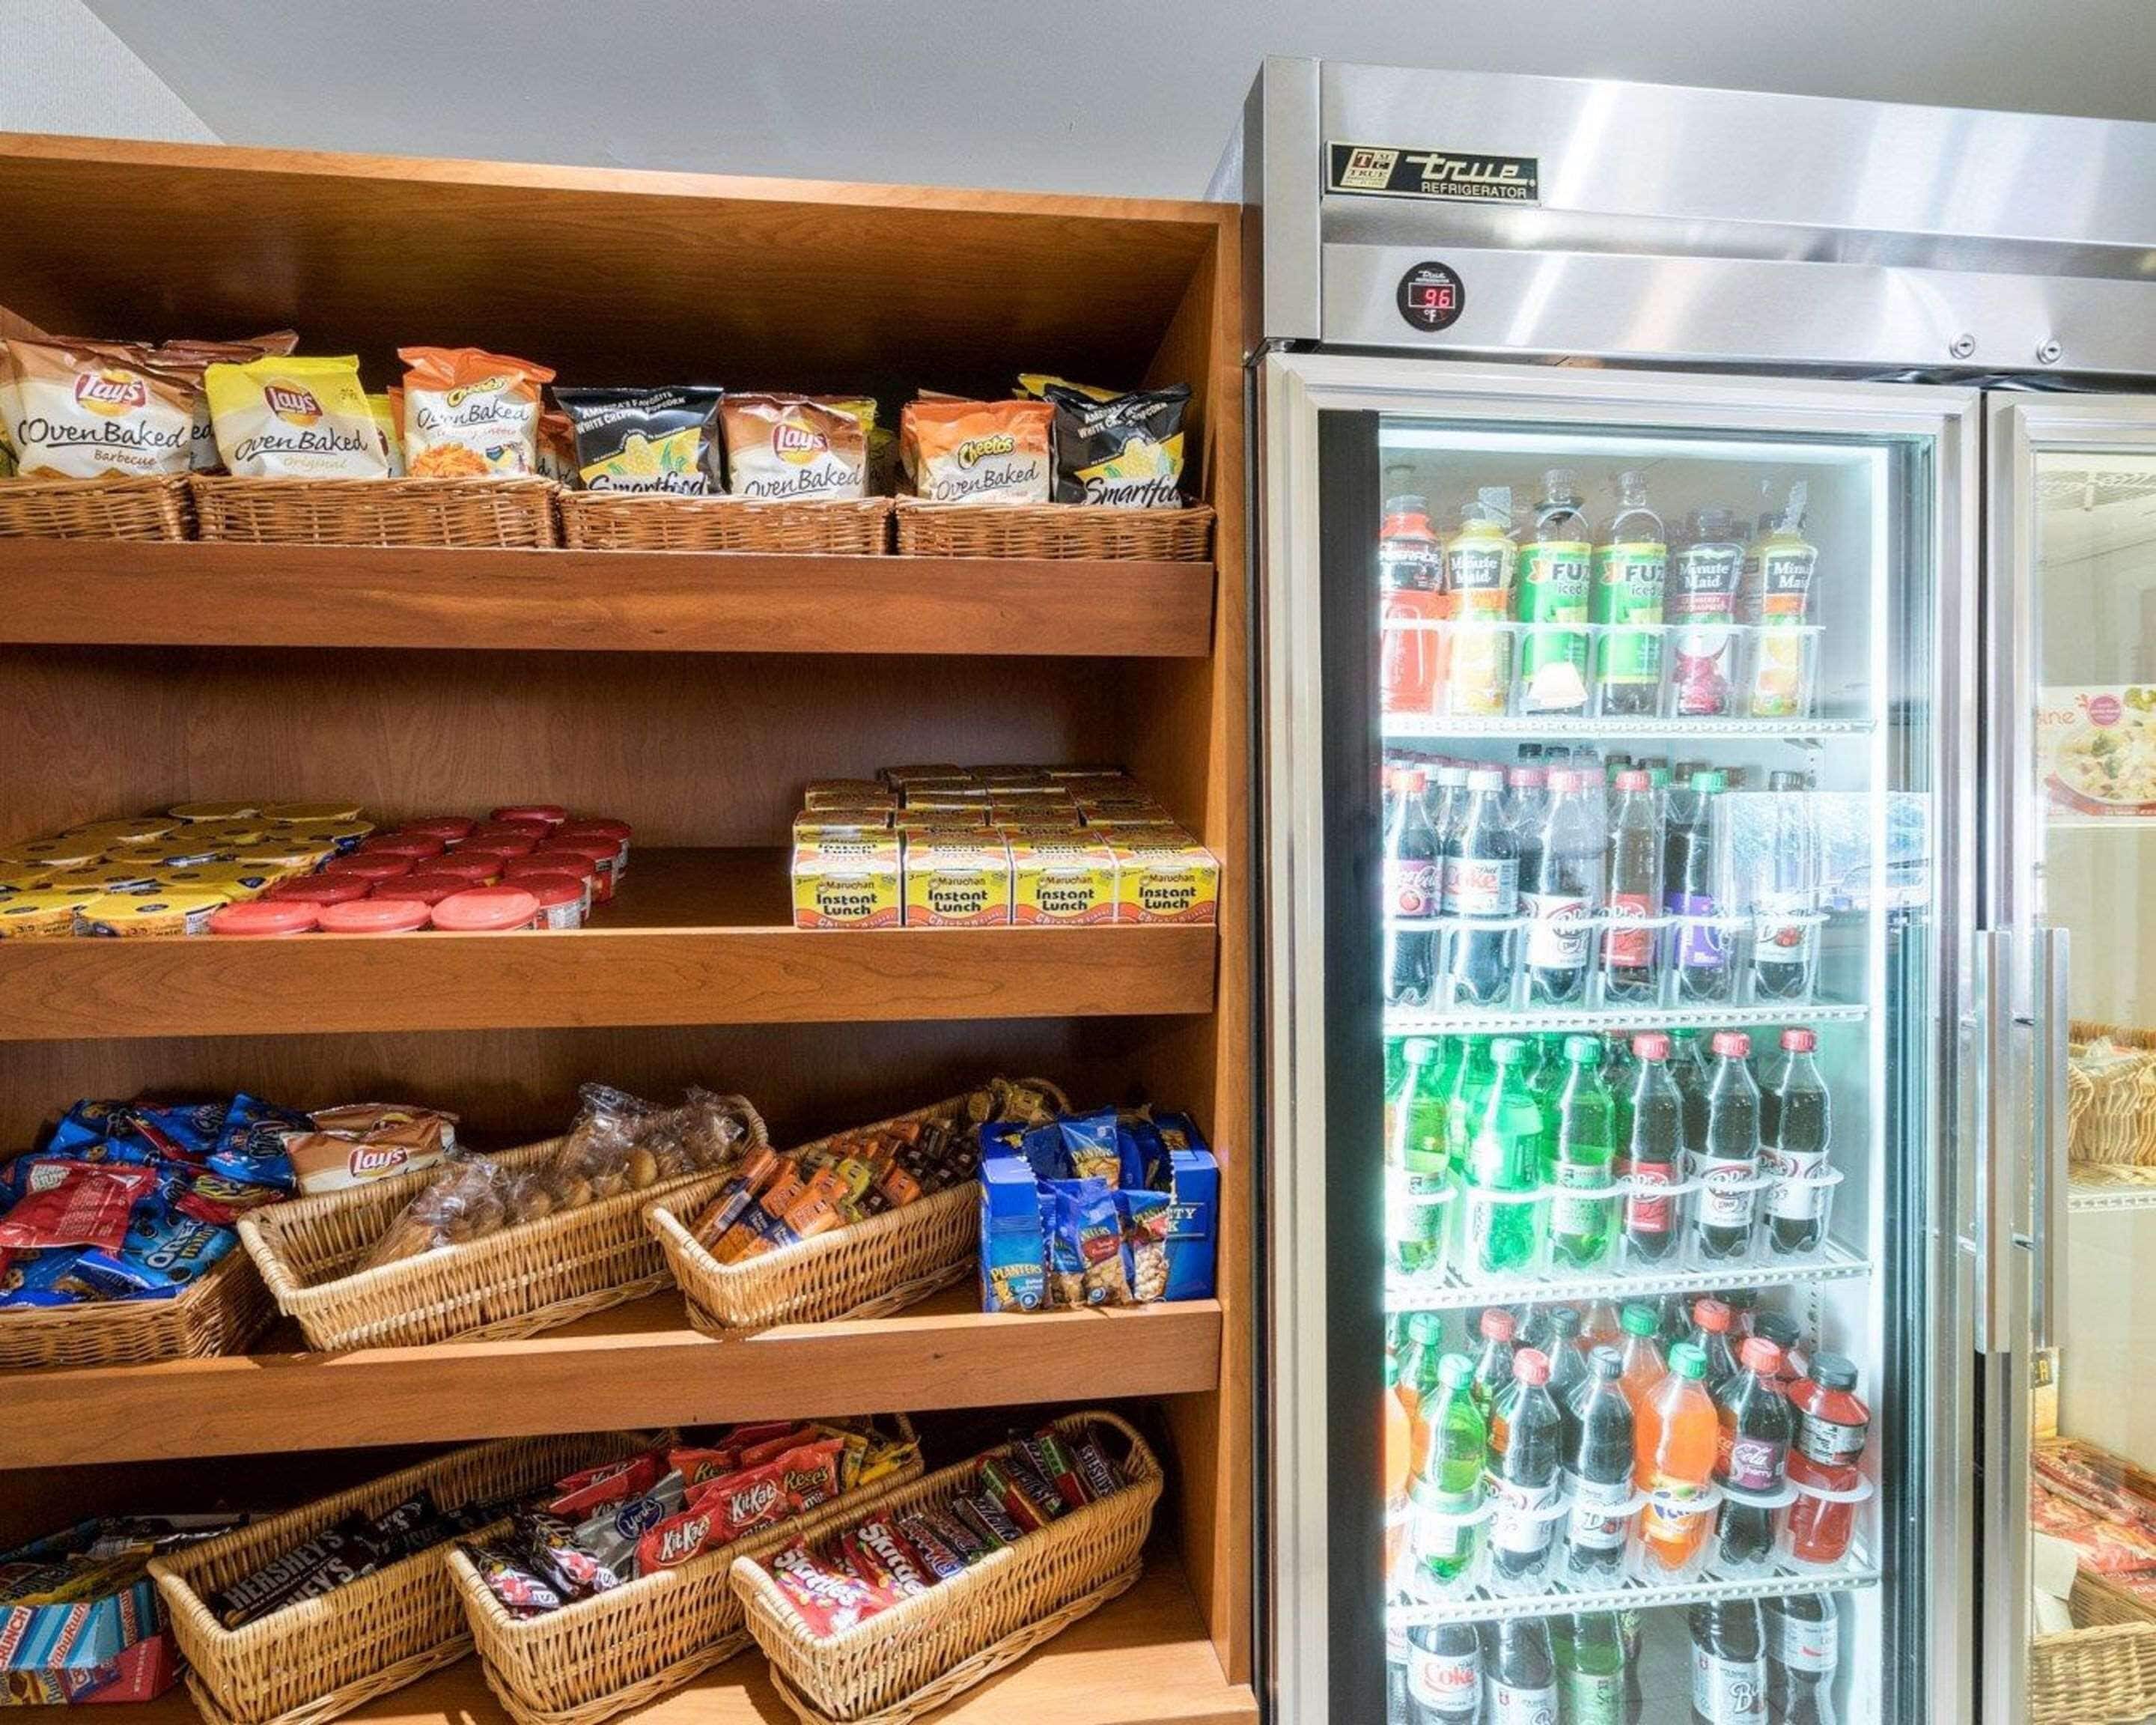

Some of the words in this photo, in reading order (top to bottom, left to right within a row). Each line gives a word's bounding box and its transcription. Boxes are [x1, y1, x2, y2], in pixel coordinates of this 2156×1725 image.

[1421, 182, 1527, 199] REFRIGERATOR
[1425, 288, 1451, 308] 96
[94, 450, 157, 467] Barbecue
[957, 435, 1015, 470] Cheetos
[1679, 562, 1729, 576] Minute
[938, 877, 986, 886] Maruchan
[1046, 875, 1094, 885] Maruchan
[1148, 874, 1196, 883] Maruchan
[928, 889, 988, 902] Instant
[1036, 888, 1094, 901] Instant
[1139, 886, 1197, 898] Instant
[816, 892, 877, 906] Instant
[1041, 899, 1088, 911] Lunch
[1145, 898, 1190, 910] Lunch
[823, 904, 871, 916] Lunch
[934, 901, 981, 913] Lunch
[990, 1263, 1043, 1282] PLANTERS
[624, 1500, 659, 1530] York
[223, 1530, 345, 1610] HERSHEY'S
[0, 1608, 28, 1670] RUNCH
